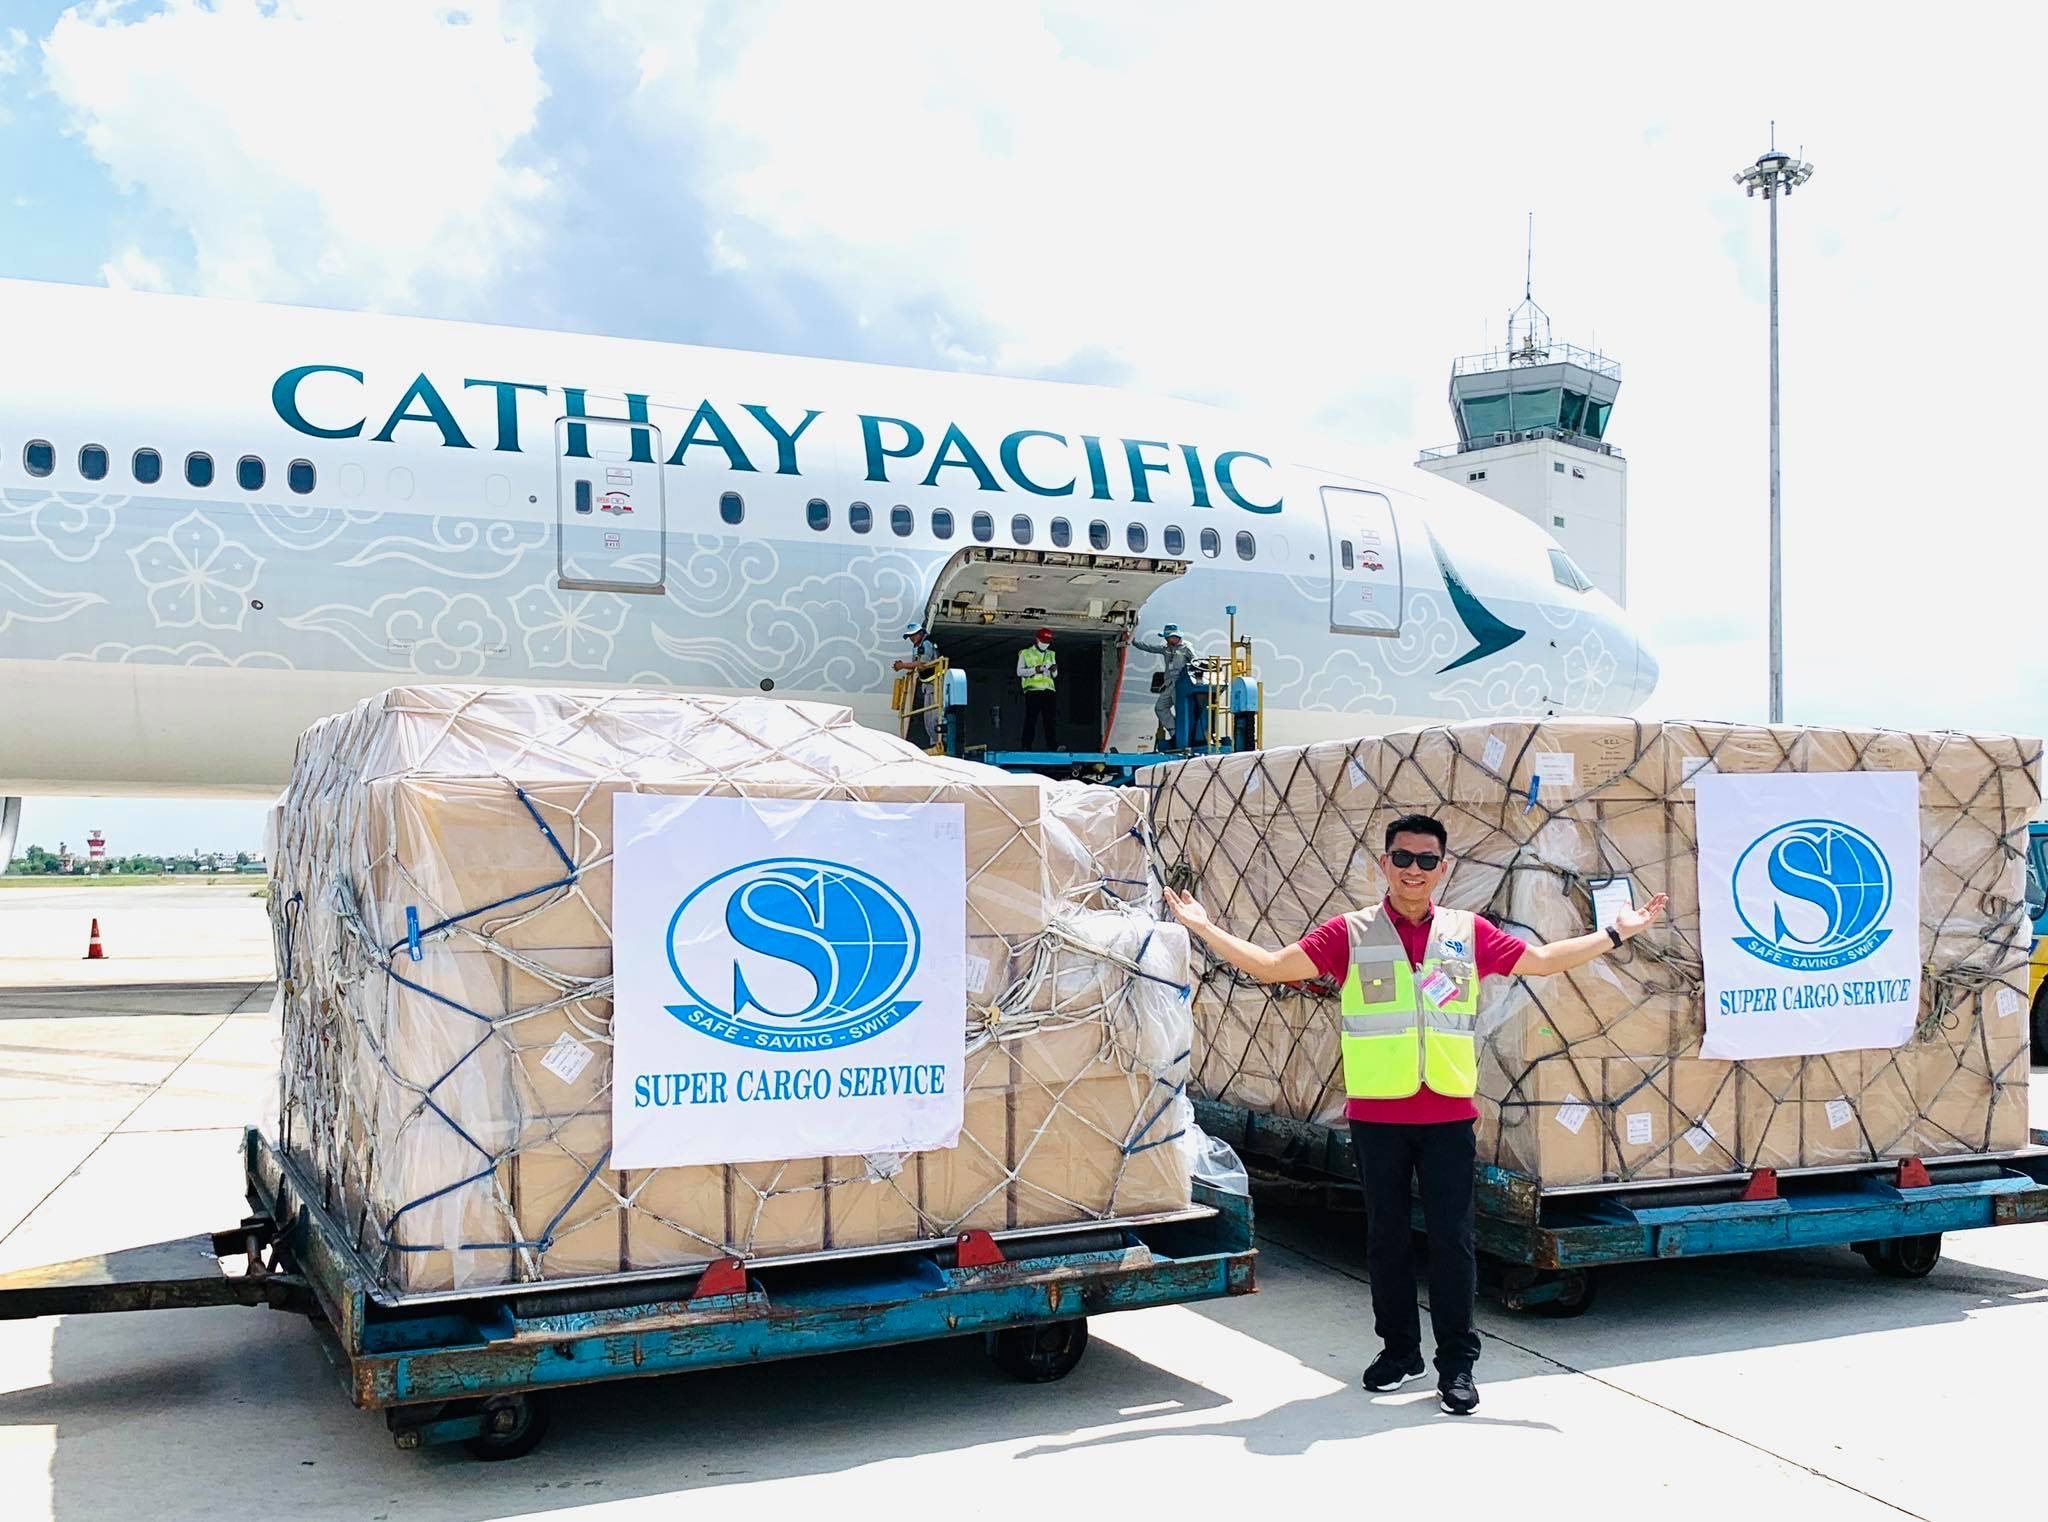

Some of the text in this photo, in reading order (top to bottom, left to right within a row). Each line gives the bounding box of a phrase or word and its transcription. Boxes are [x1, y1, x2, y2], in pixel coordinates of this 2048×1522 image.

[271, 364, 1284, 515] CATHAY PACIFIC
[1748, 940, 1782, 963] SAFE
[1791, 956, 1839, 968] SAVING
[1847, 934, 1881, 960] SWIFT
[1719, 978, 1912, 1016] SUPER CARGO SERVICE
[688, 1009, 741, 1039] SAFE
[755, 1032, 833, 1049] SAVING
[848, 1006, 901, 1040] SWIFT
[634, 1064, 946, 1108] SUPER CARGO SERVICE
